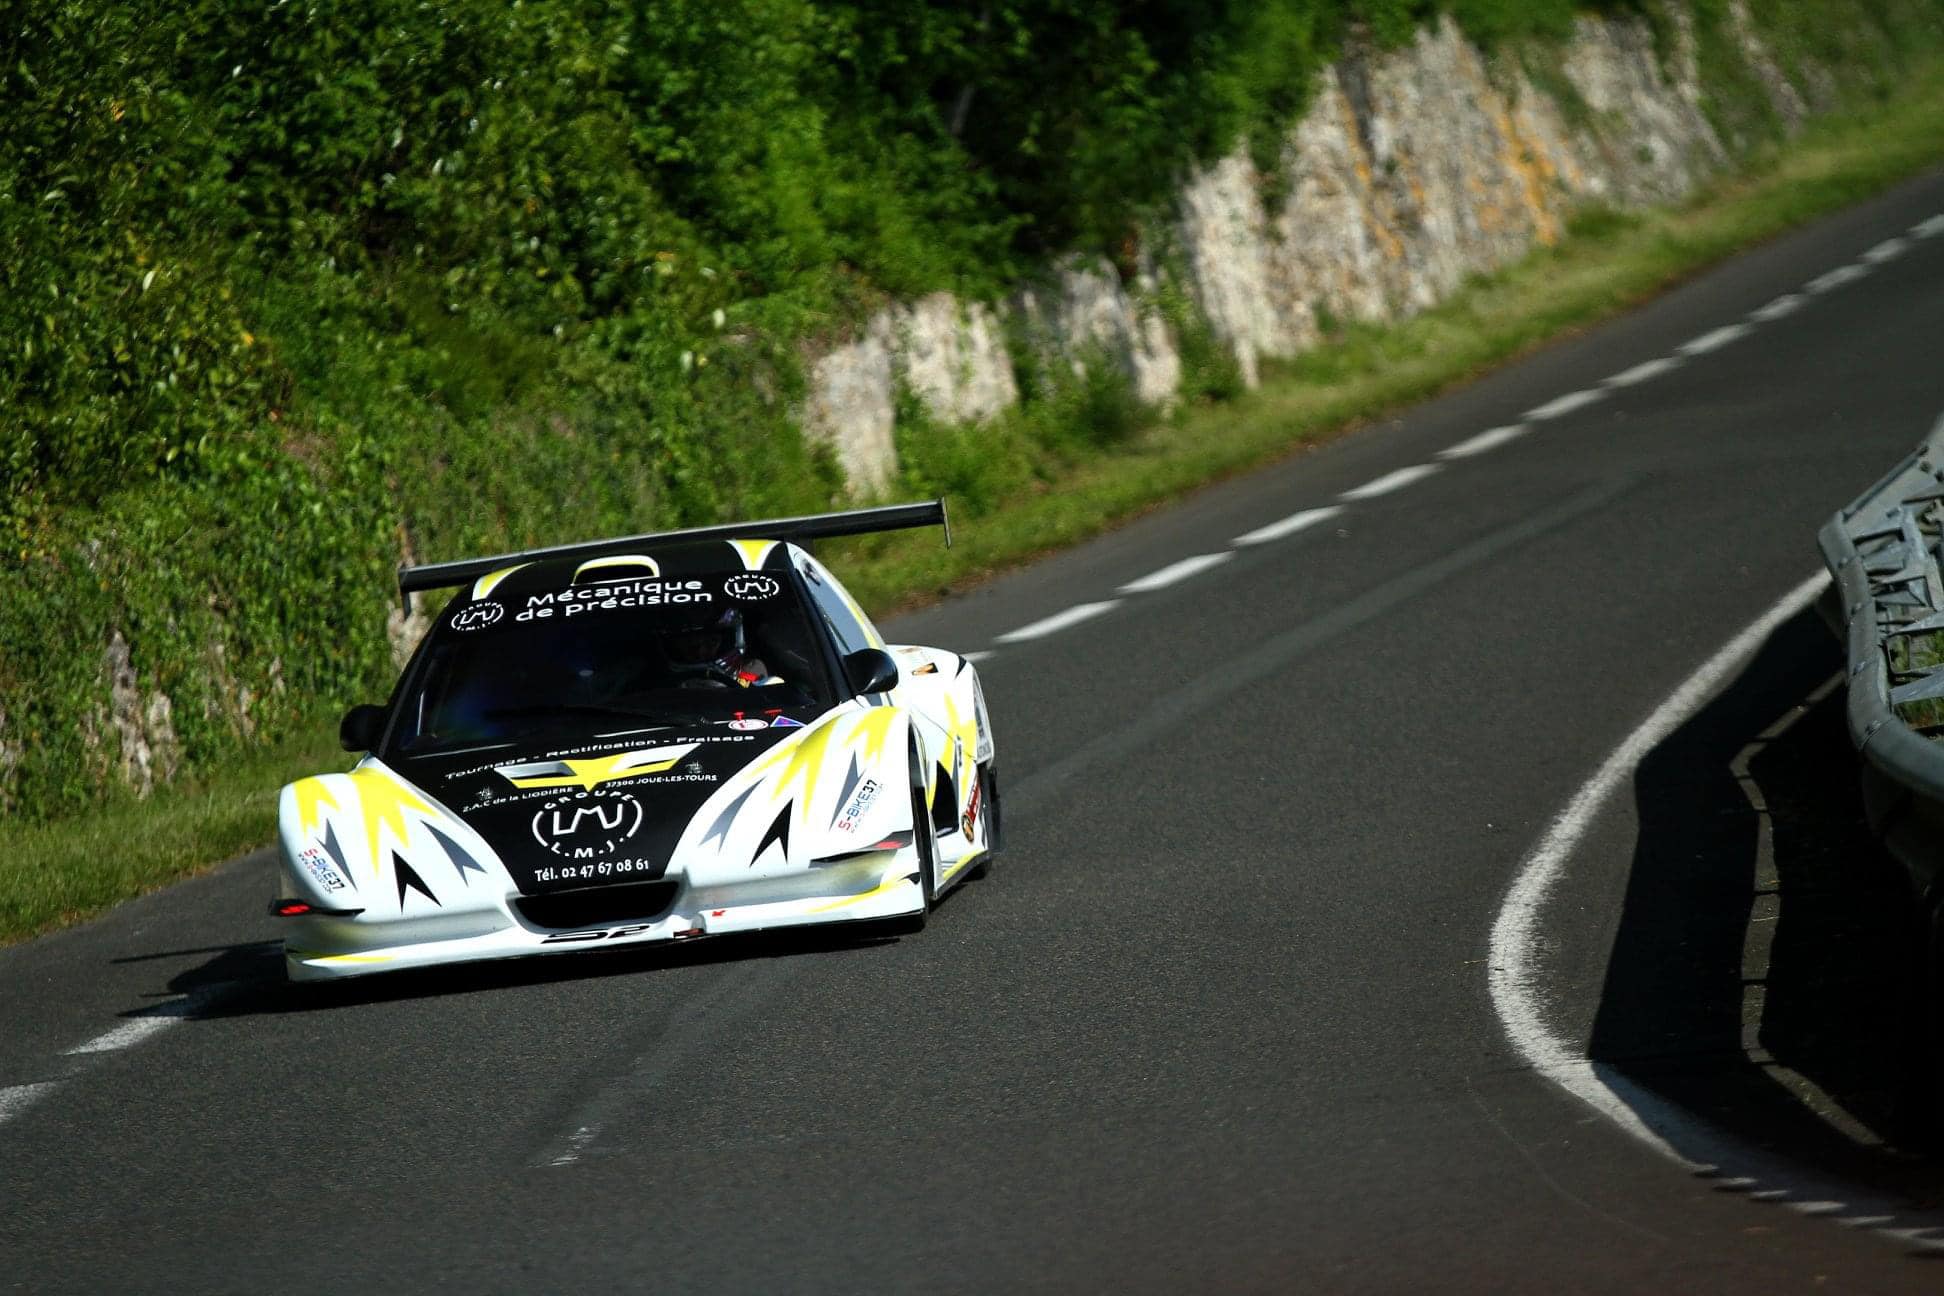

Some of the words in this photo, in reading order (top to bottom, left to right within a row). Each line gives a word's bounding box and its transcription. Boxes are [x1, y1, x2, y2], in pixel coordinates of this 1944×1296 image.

[527, 580, 703, 607] Mécanique
[515, 608, 553, 621] de
[565, 592, 713, 617] précision
[445, 757, 527, 779] Tournage
[546, 739, 657, 758] Rectification
[676, 735, 755, 744] Fraisage
[605, 779, 634, 789] 37300
[636, 774, 717, 785] JOUE-LES-TOURS
[493, 797, 507, 806] de
[509, 794, 519, 802] la
[544, 790, 634, 809] GROUPE
[535, 867, 558, 881] Tél.
[562, 867, 576, 878] 02
[580, 865, 594, 878] 47
[598, 861, 612, 876] 67
[616, 859, 632, 872] 08
[635, 858, 649, 870] 61
